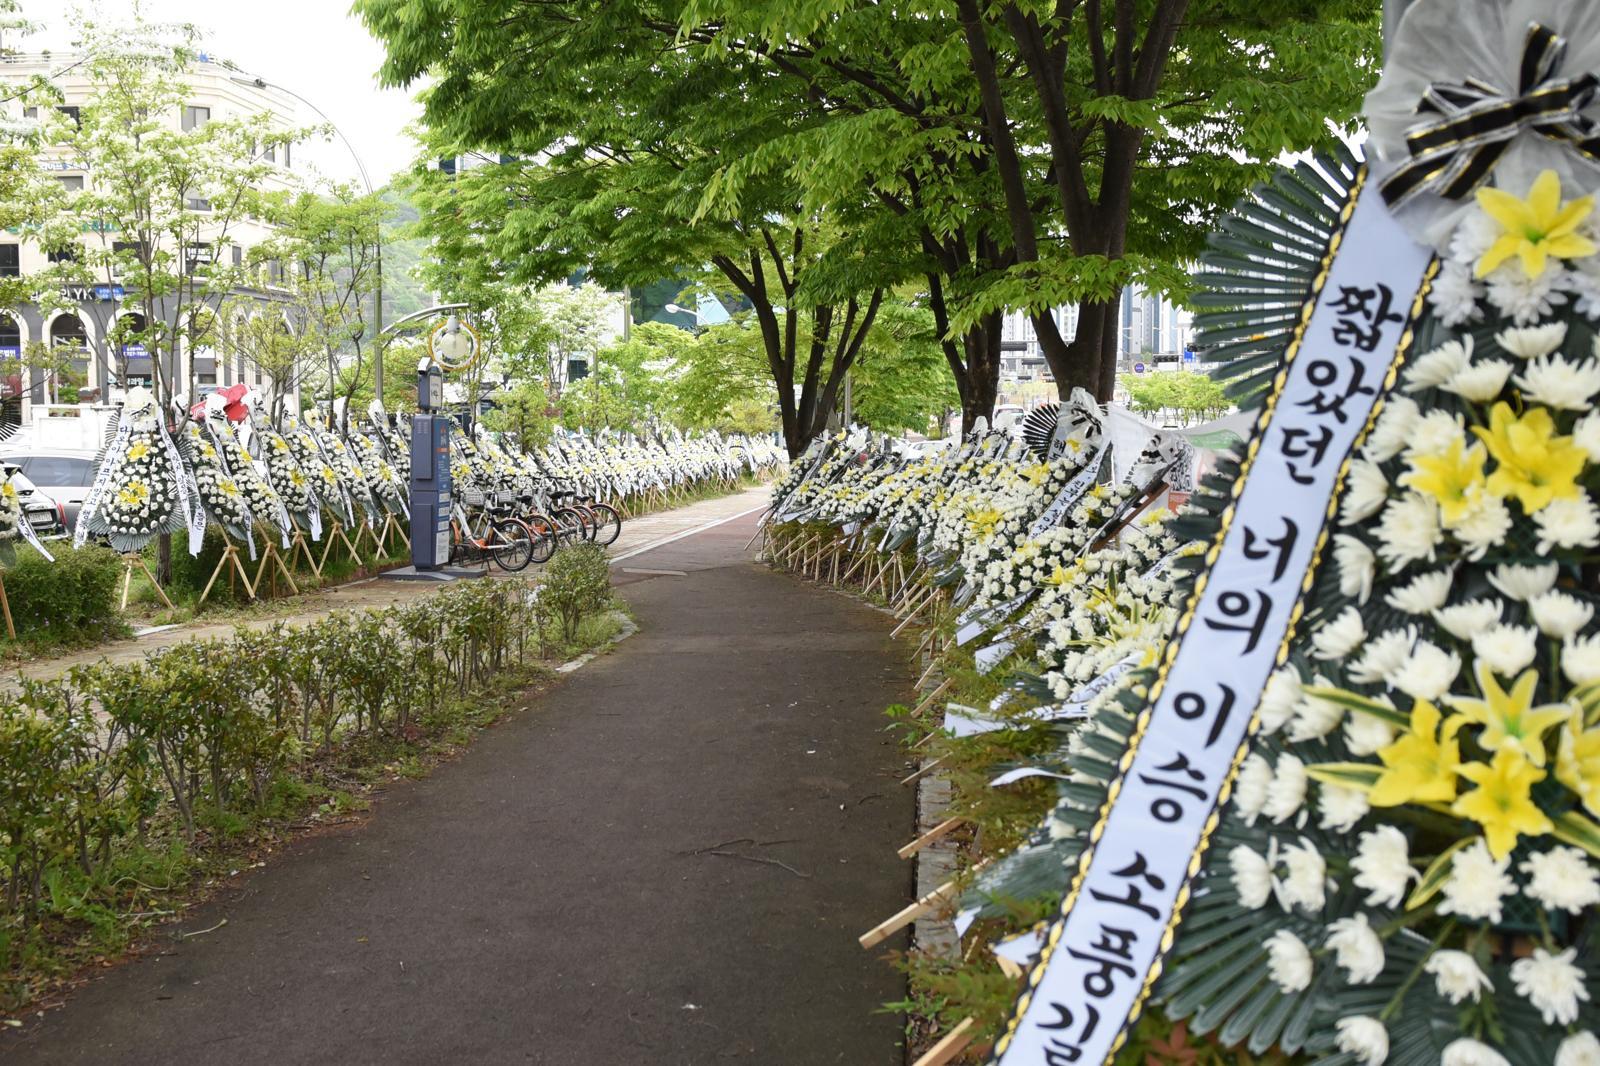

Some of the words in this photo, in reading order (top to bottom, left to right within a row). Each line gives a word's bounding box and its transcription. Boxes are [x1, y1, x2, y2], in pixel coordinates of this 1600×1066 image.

[74, 288, 93, 300] YK
[1281, 283, 1404, 485] 짧았던
[1203, 515, 1298, 656] 너의
[1138, 682, 1237, 823] 이승
